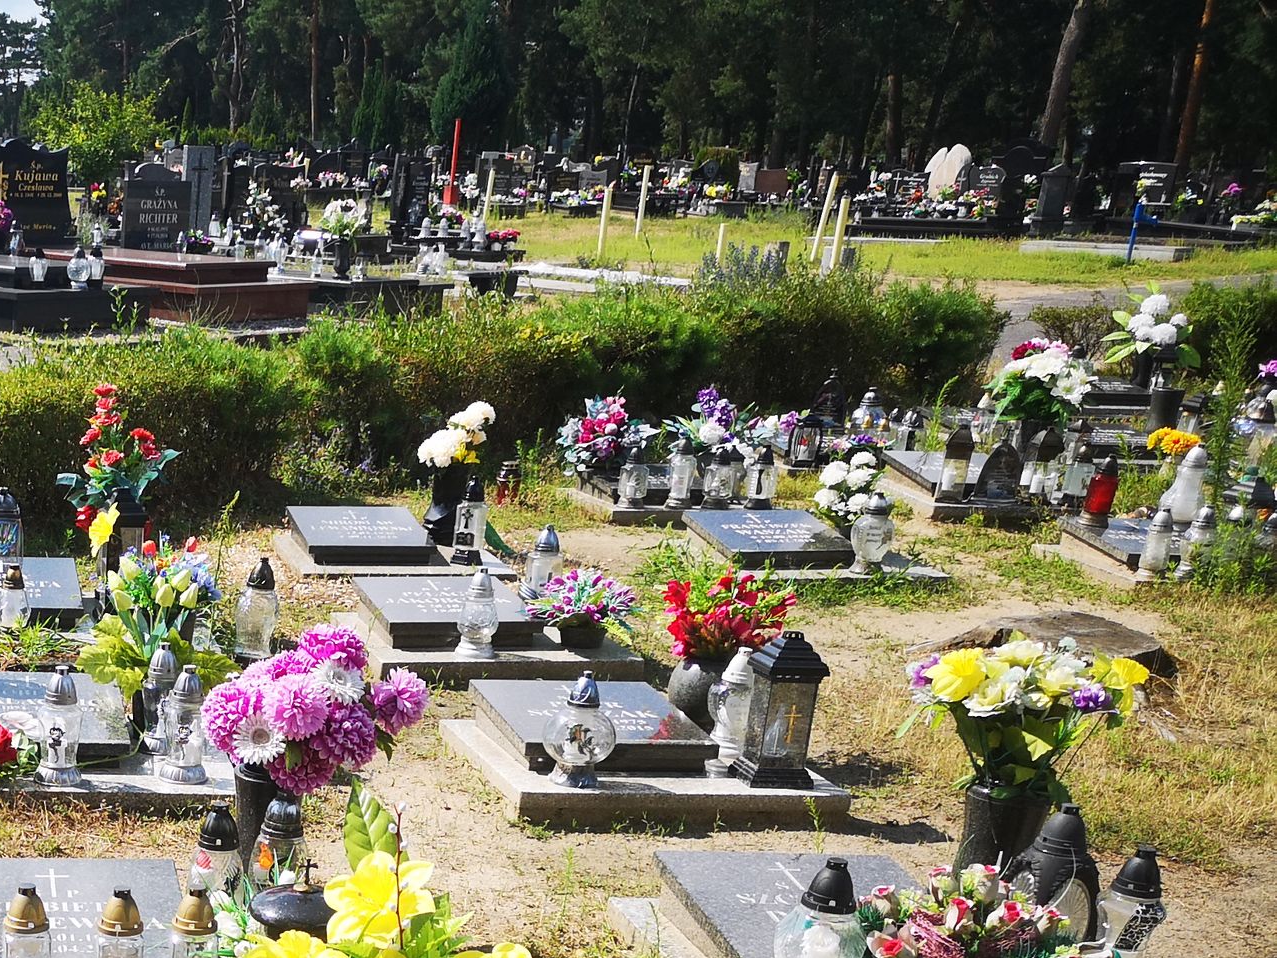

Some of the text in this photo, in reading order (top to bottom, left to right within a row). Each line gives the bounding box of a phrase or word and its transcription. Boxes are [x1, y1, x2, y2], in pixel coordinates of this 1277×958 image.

[15, 169, 59, 183] Kujawa
[140, 197, 179, 210] GRAŻYNA
[139, 213, 179, 224] RICHTER
